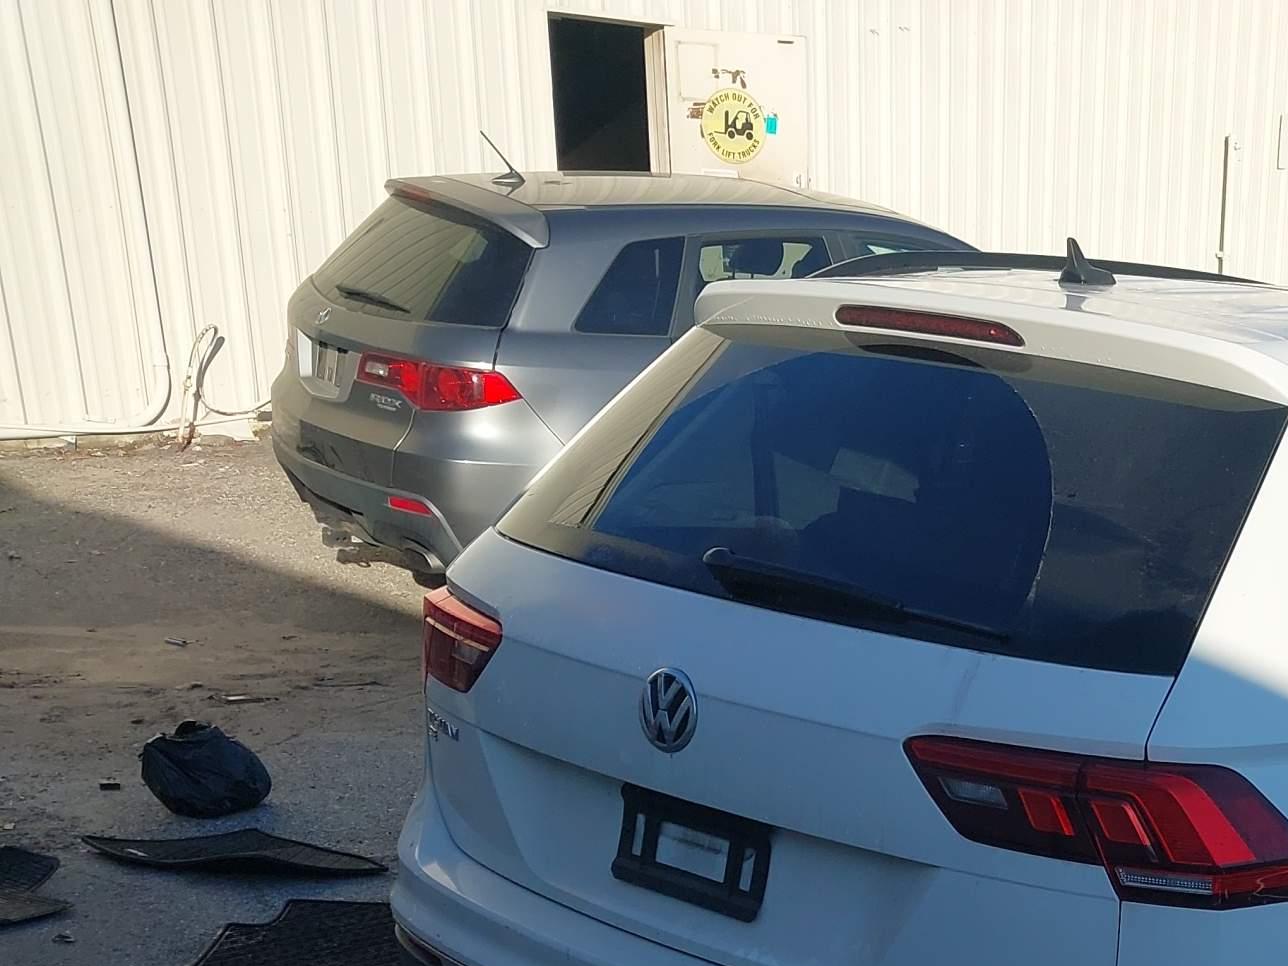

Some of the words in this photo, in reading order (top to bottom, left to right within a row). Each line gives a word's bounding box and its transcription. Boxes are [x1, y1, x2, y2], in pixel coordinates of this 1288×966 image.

[706, 92, 729, 114] WATCH
[732, 92, 747, 104] OUT
[747, 102, 760, 120] FOR
[707, 132, 720, 152] FORK
[721, 149, 736, 160] LIFT
[737, 139, 760, 160] TRUCKS
[643, 669, 695, 750] VW
